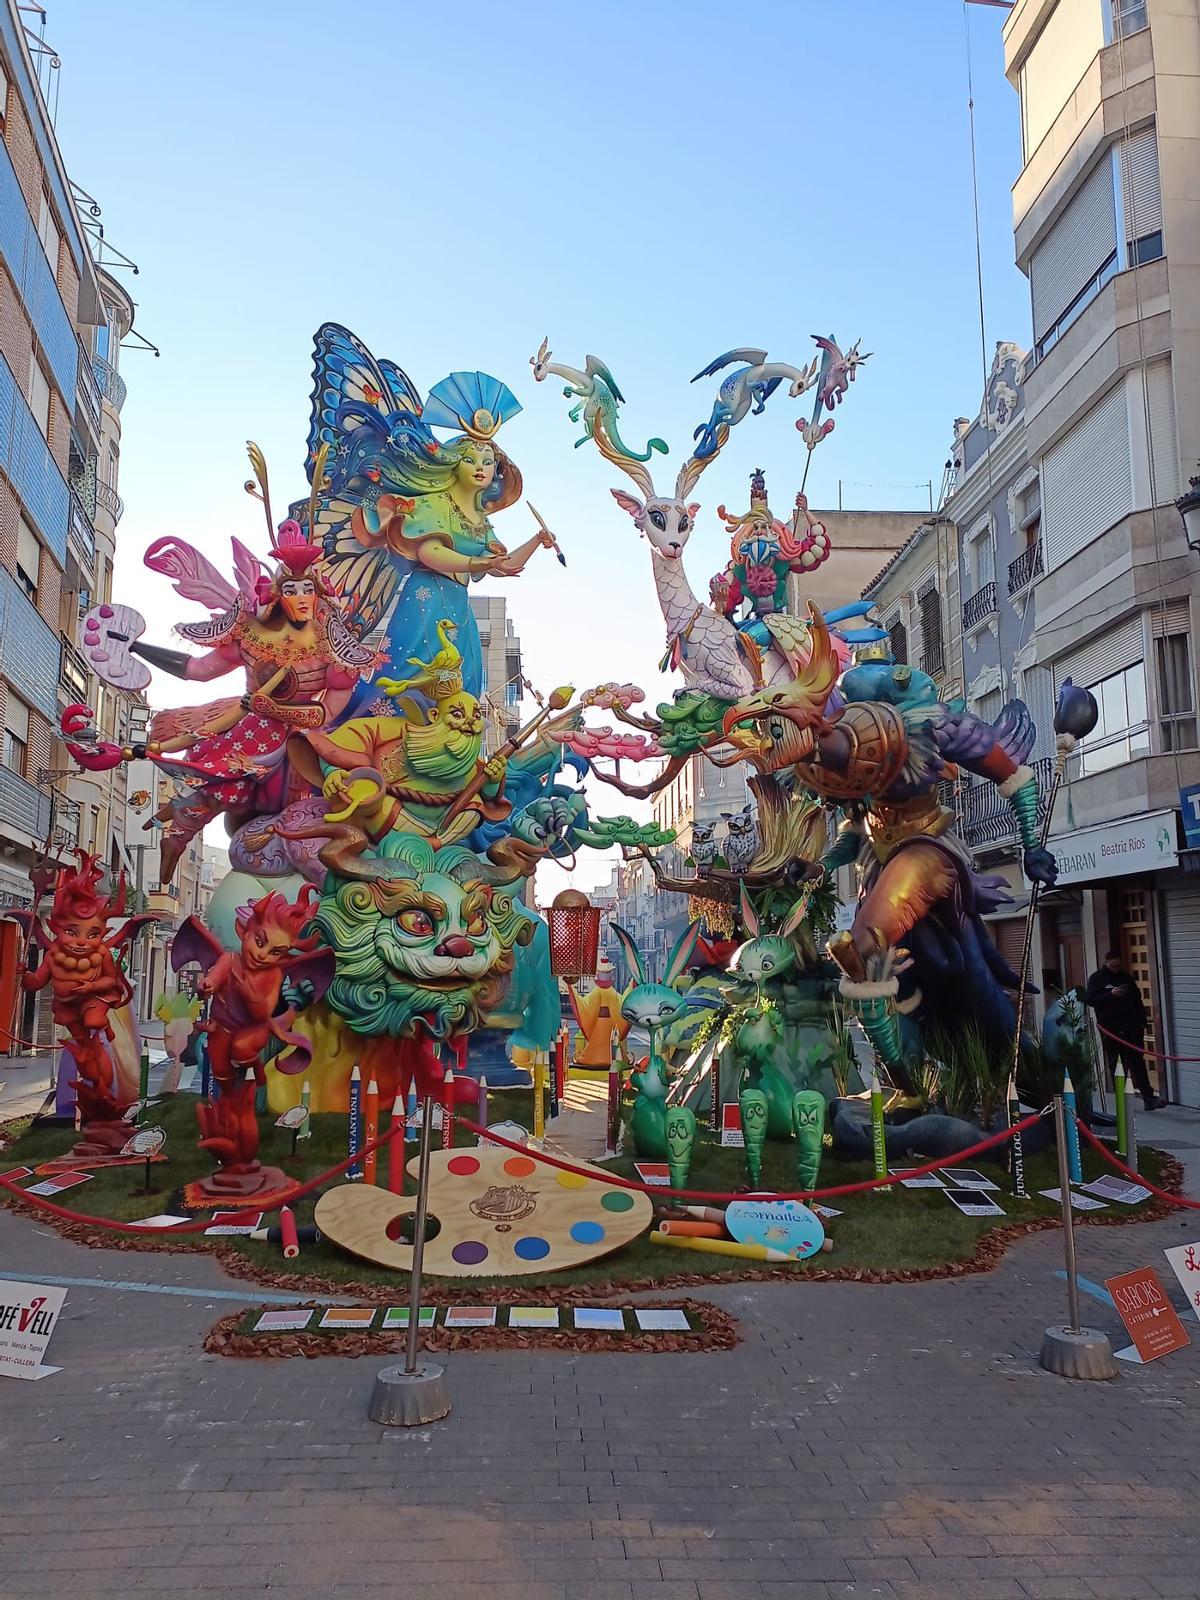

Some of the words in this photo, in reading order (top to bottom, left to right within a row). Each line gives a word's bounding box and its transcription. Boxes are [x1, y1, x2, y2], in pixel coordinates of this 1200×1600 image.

[1056, 852, 1097, 875] EBARAN
[1101, 839, 1128, 857] Beatriz
[350, 1096, 358, 1134] ANTONI
[874, 1121, 884, 1173] BULEVAR
[1013, 1120, 1023, 1158] LOCL
[1015, 1159, 1025, 1195] JUNTA
[1115, 1279, 1161, 1313] SABORS
[18, 1297, 54, 1336] VELL
